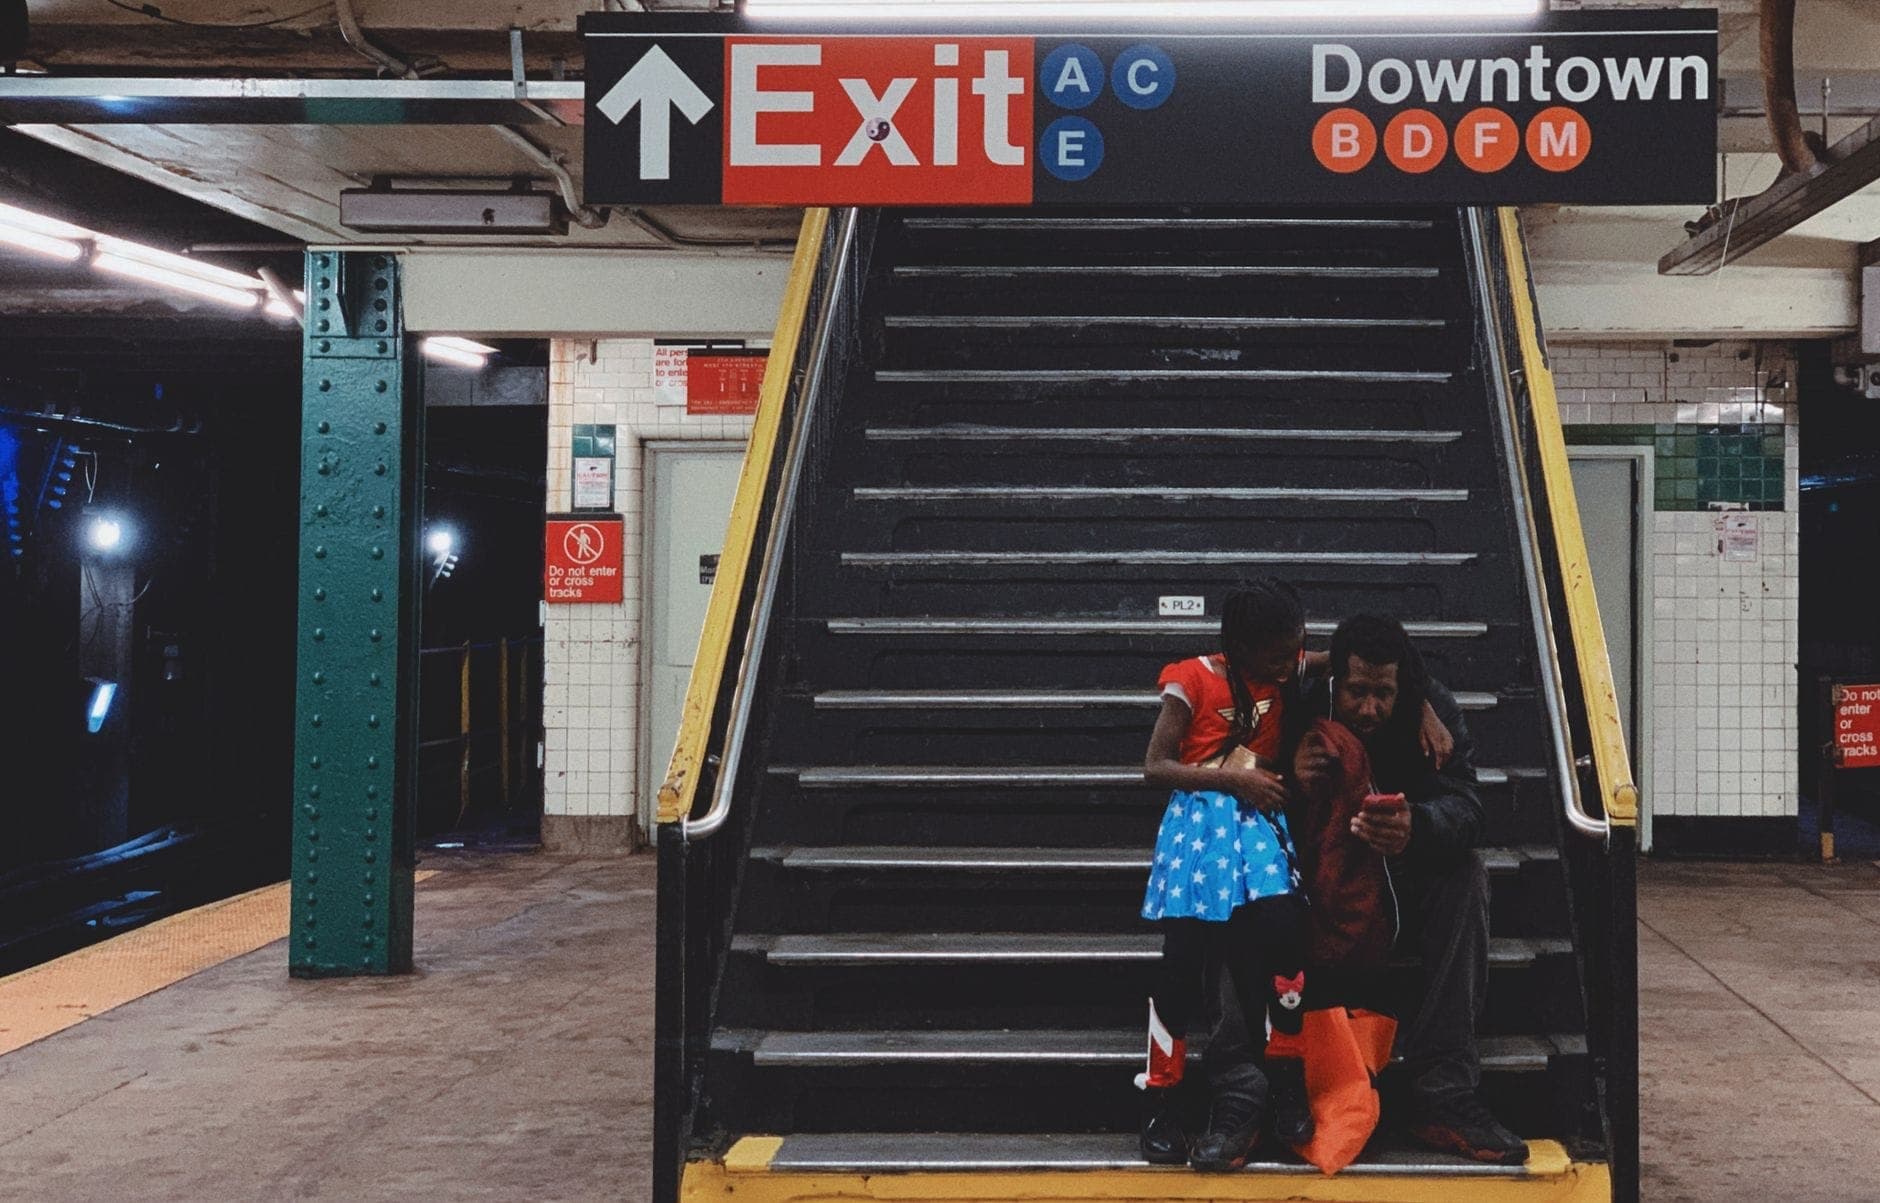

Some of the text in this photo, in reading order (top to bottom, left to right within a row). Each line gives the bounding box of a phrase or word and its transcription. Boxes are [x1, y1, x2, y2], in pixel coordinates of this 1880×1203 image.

[1054, 57, 1159, 95] A C
[1312, 44, 1709, 104] Downtown
[730, 44, 1025, 167] Exit
[1331, 121, 1577, 158] B D F M
[1058, 131, 1085, 166] E
[655, 348, 667, 356] All
[549, 565, 617, 576] Do not enter
[549, 577, 594, 586] or cross
[549, 587, 583, 598] tracks
[1172, 599, 1195, 610] PL2
[1861, 688, 1880, 701] not
[1840, 704, 1871, 715] enter
[1840, 719, 1853, 729] or
[1840, 732, 1873, 743] cross
[1842, 744, 1878, 756] racks
